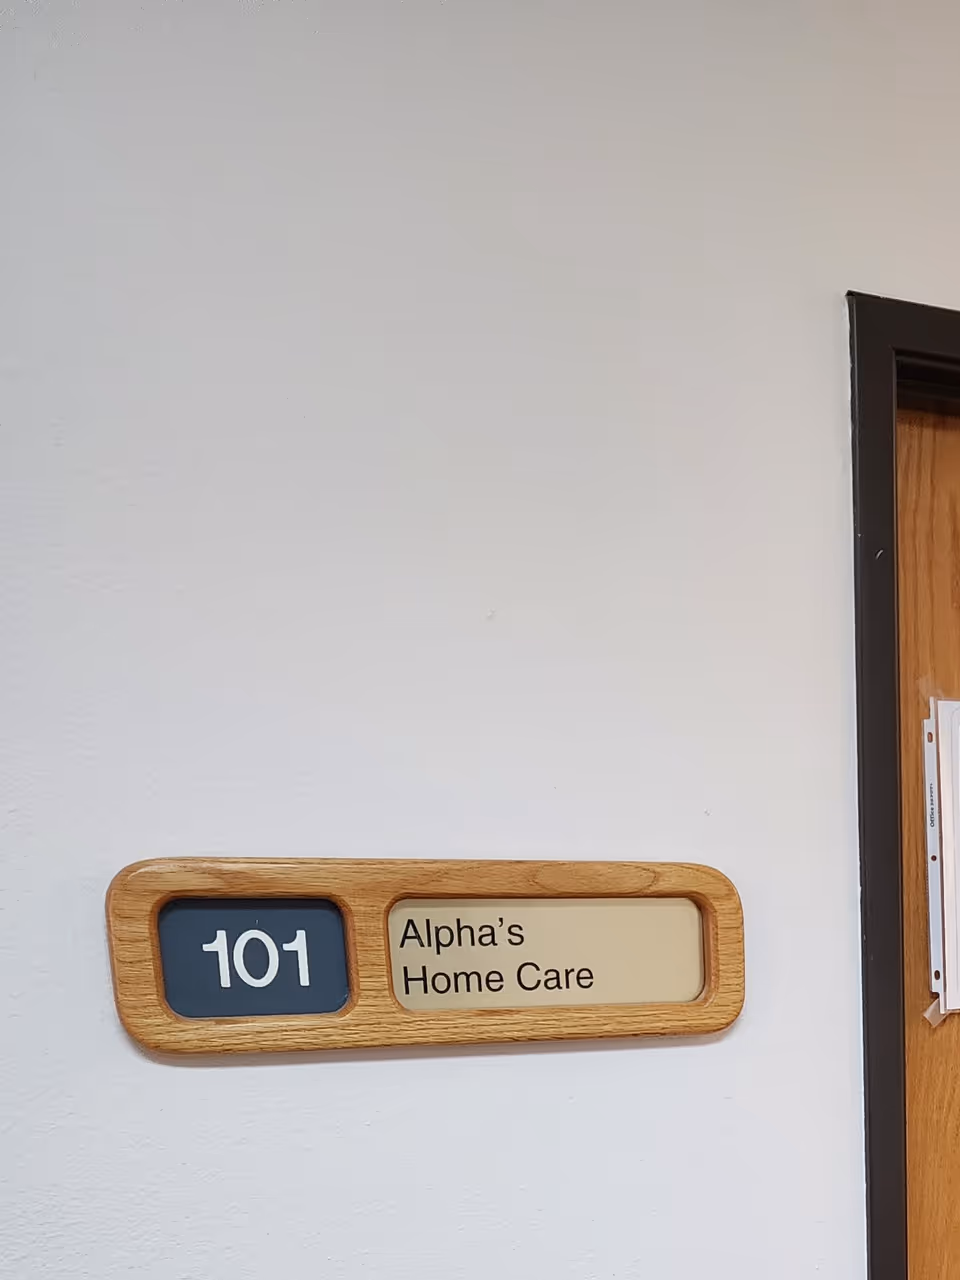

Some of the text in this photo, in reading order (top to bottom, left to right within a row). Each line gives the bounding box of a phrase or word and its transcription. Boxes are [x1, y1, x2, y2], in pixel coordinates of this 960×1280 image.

[400, 917, 526, 954] Alpha’s
[202, 929, 311, 988] 101
[403, 961, 594, 996] Home Care
